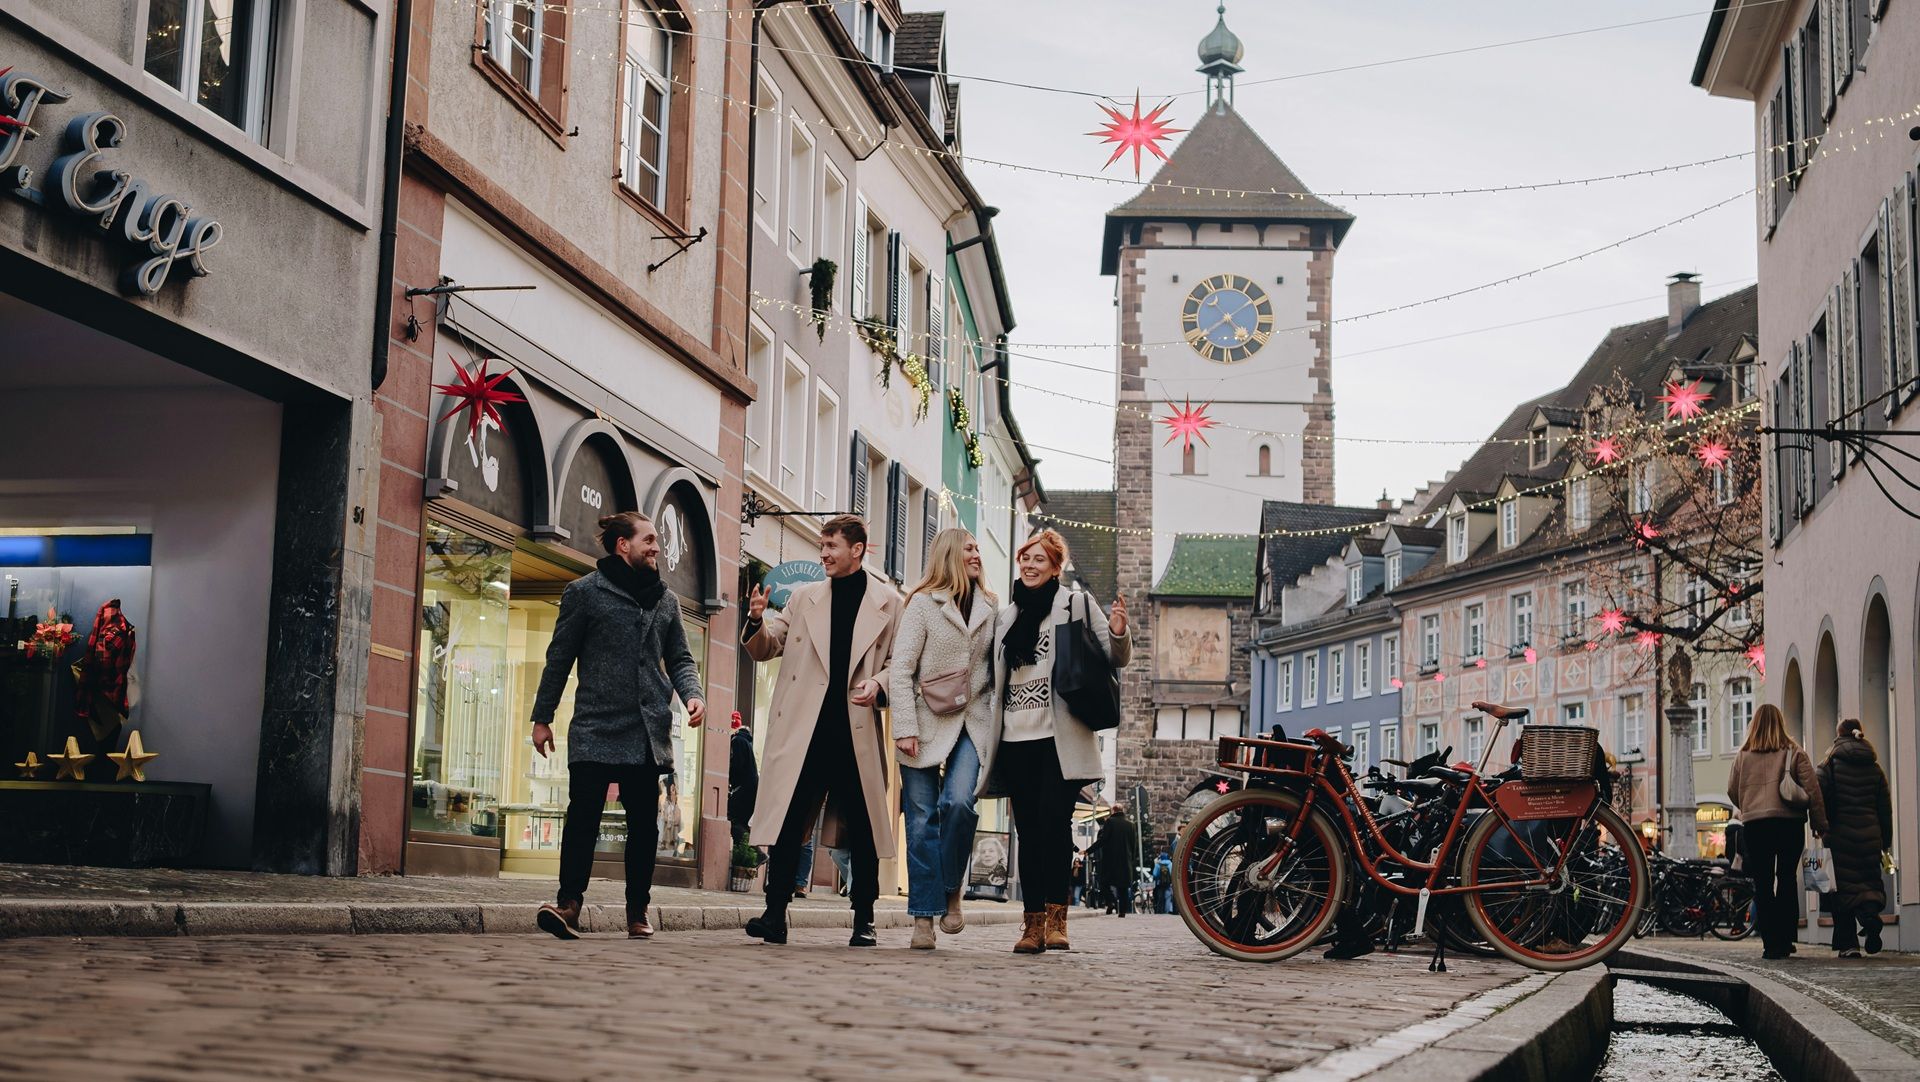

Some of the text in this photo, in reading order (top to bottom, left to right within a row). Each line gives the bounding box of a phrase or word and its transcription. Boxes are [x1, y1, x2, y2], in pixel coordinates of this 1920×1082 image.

[58, 112, 223, 297] Enge
[581, 484, 602, 510] CIGO
[353, 505, 365, 525] 51
